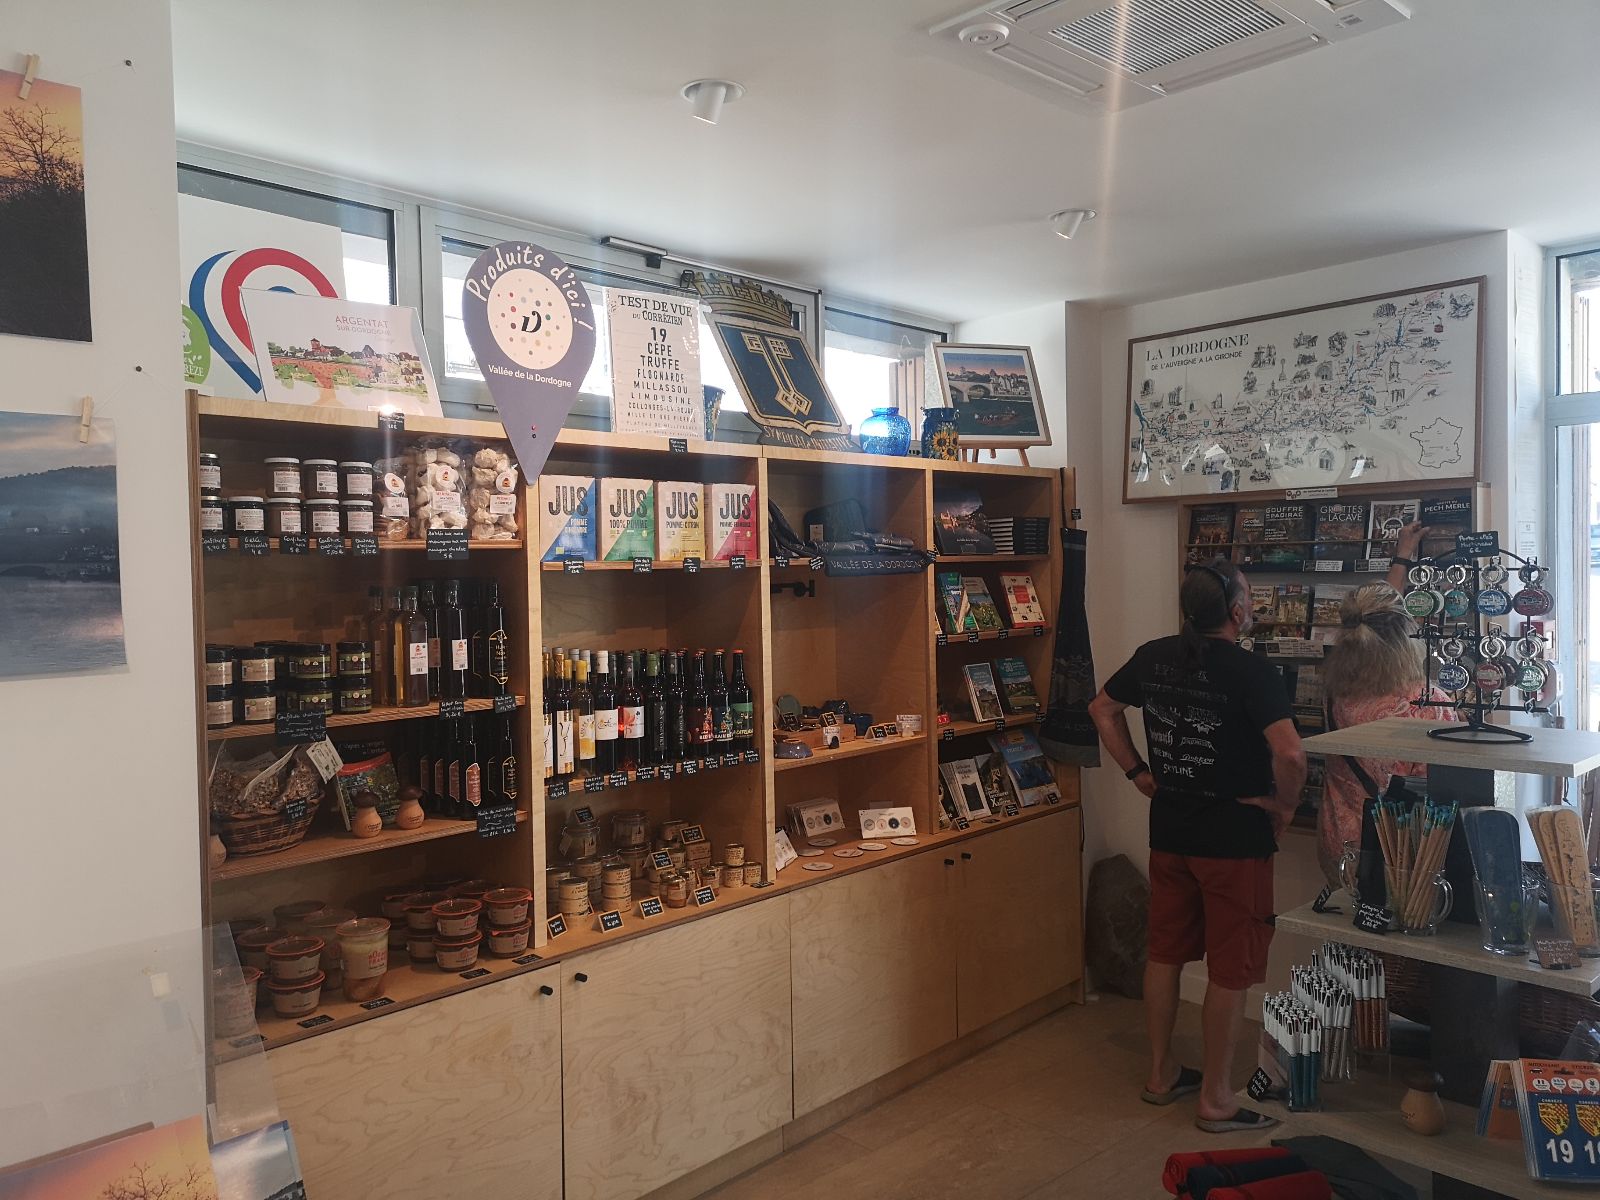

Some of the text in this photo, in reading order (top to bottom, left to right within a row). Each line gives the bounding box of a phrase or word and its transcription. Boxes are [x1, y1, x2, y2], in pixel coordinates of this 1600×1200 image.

[465, 245, 545, 302] Produits
[550, 265, 586, 309] d'ici
[618, 294, 693, 318] TEST DE VUE
[335, 315, 390, 329] ARGENTAT
[336, 324, 350, 332] SUR
[650, 326, 667, 343] 19
[1146, 333, 1249, 362] LA DORDOGNE
[640, 355, 680, 371] TRUFFE
[1160, 359, 1197, 370] L'AUVERGNE
[1205, 355, 1213, 363] LA
[1214, 351, 1243, 361] GIRONDE
[488, 364, 572, 388] Vallée de la Dordogne
[634, 381, 688, 395] MILLASSOU
[631, 392, 691, 405] LIMOUSINE
[548, 485, 589, 516] JUS
[610, 489, 647, 517] JUS
[666, 492, 699, 520] JUS
[719, 493, 751, 520] JUS
[1424, 502, 1471, 513] PECH MERLE
[1265, 506, 1304, 514] GOUFFRE
[1328, 513, 1363, 522] LACAVE
[609, 519, 626, 529] 100%
[831, 559, 861, 570] VALLÉE
[863, 560, 874, 570] DE
[876, 560, 885, 569] LA
[885, 558, 925, 569] DORDOGNE
[1163, 763, 1196, 778] SKYLINE
[1546, 1138, 1574, 1164] 19
